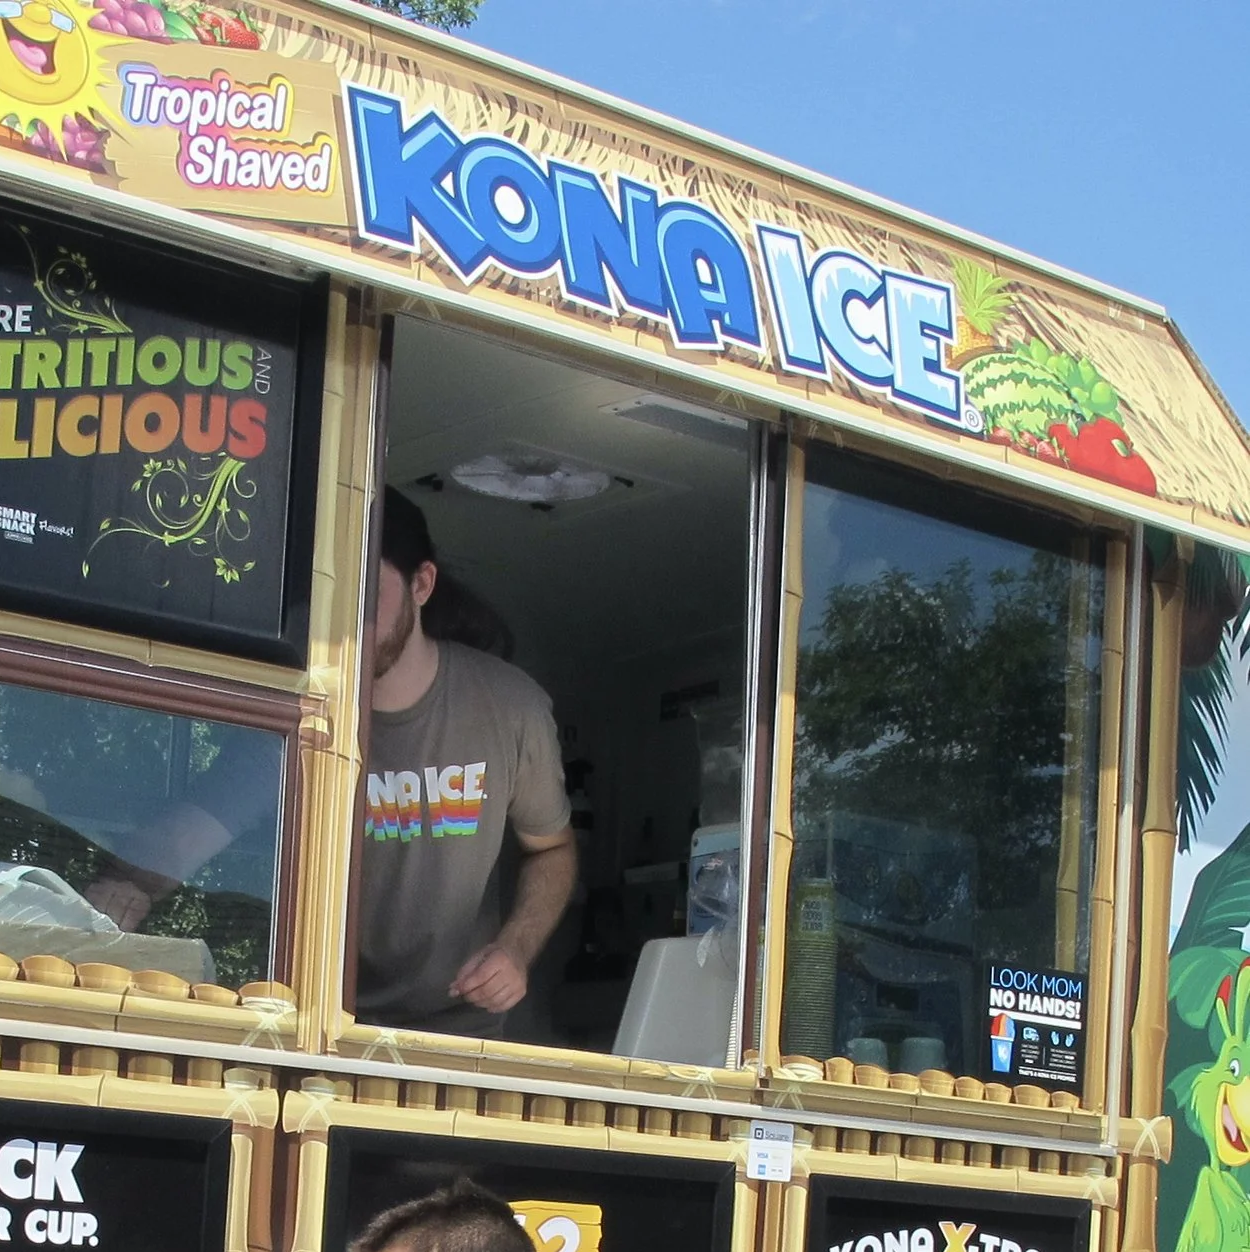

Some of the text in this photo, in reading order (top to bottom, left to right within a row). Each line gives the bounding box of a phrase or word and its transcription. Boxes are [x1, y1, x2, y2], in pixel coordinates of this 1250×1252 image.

[126, 71, 288, 137] Tropical
[184, 135, 333, 193] Shaved
[342, 82, 965, 427] KONA ICE
[255, 346, 272, 395] AND
[366, 770, 422, 820] NA
[990, 966, 1082, 999] LOOK MOM
[990, 988, 1082, 1020] NO HANDS!
[25, 1209, 99, 1248] CUP.
